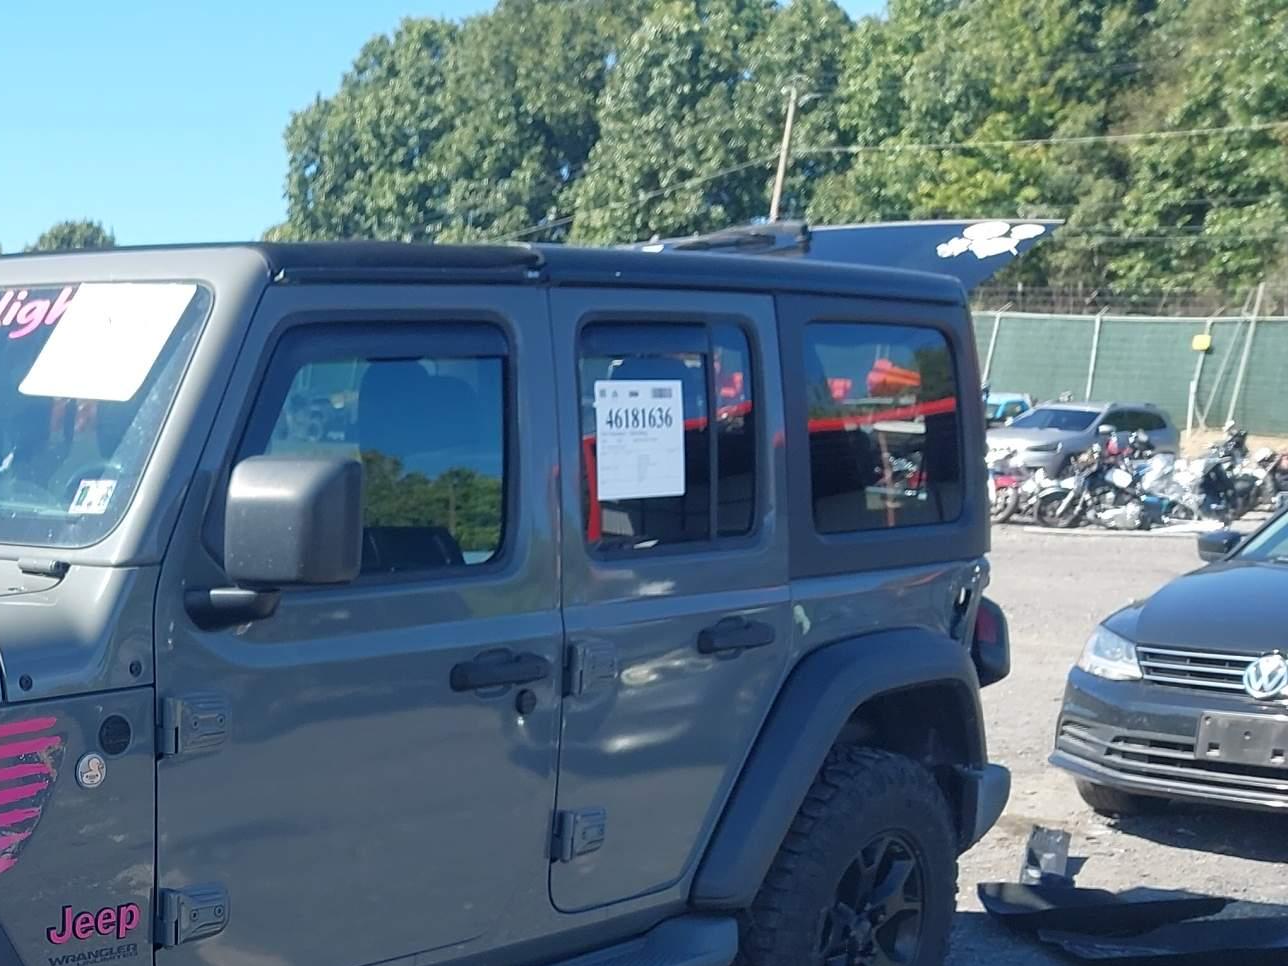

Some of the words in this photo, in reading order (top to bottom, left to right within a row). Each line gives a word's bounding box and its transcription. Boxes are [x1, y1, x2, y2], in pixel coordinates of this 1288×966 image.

[606, 407, 673, 429] 46181636
[46, 902, 141, 945] Jeep
[48, 943, 138, 966] WRANGLER
